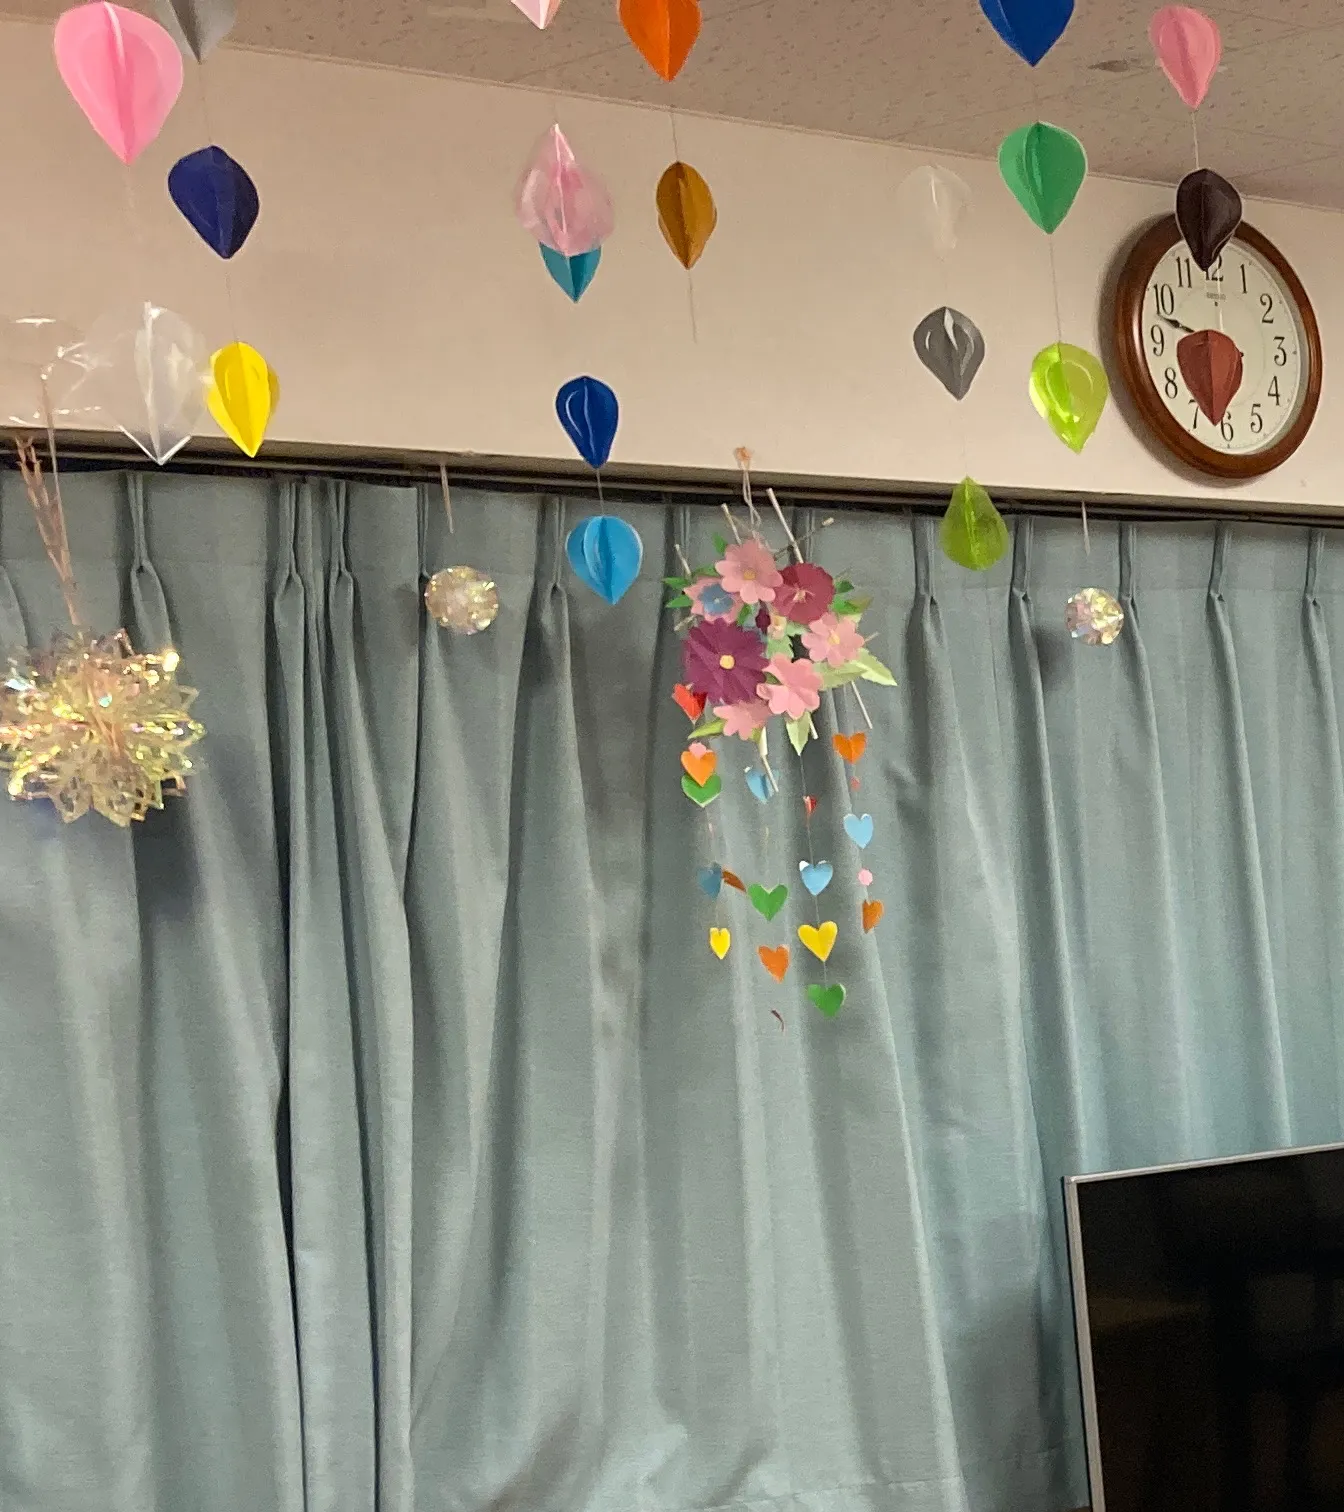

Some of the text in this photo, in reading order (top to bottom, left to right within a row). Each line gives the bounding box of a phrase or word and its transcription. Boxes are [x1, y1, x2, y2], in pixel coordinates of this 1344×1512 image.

[1176, 256, 1192, 288] 11
[1240, 263, 1247, 294] 1
[1153, 283, 1175, 316] 10
[1260, 293, 1274, 324] 2
[1150, 324, 1165, 357] 9
[1273, 336, 1287, 367] 3
[1164, 367, 1178, 399] 8
[1267, 375, 1281, 406] 4
[1188, 399, 1200, 430] 7
[1220, 410, 1234, 442] 6
[1250, 403, 1263, 434] 5
